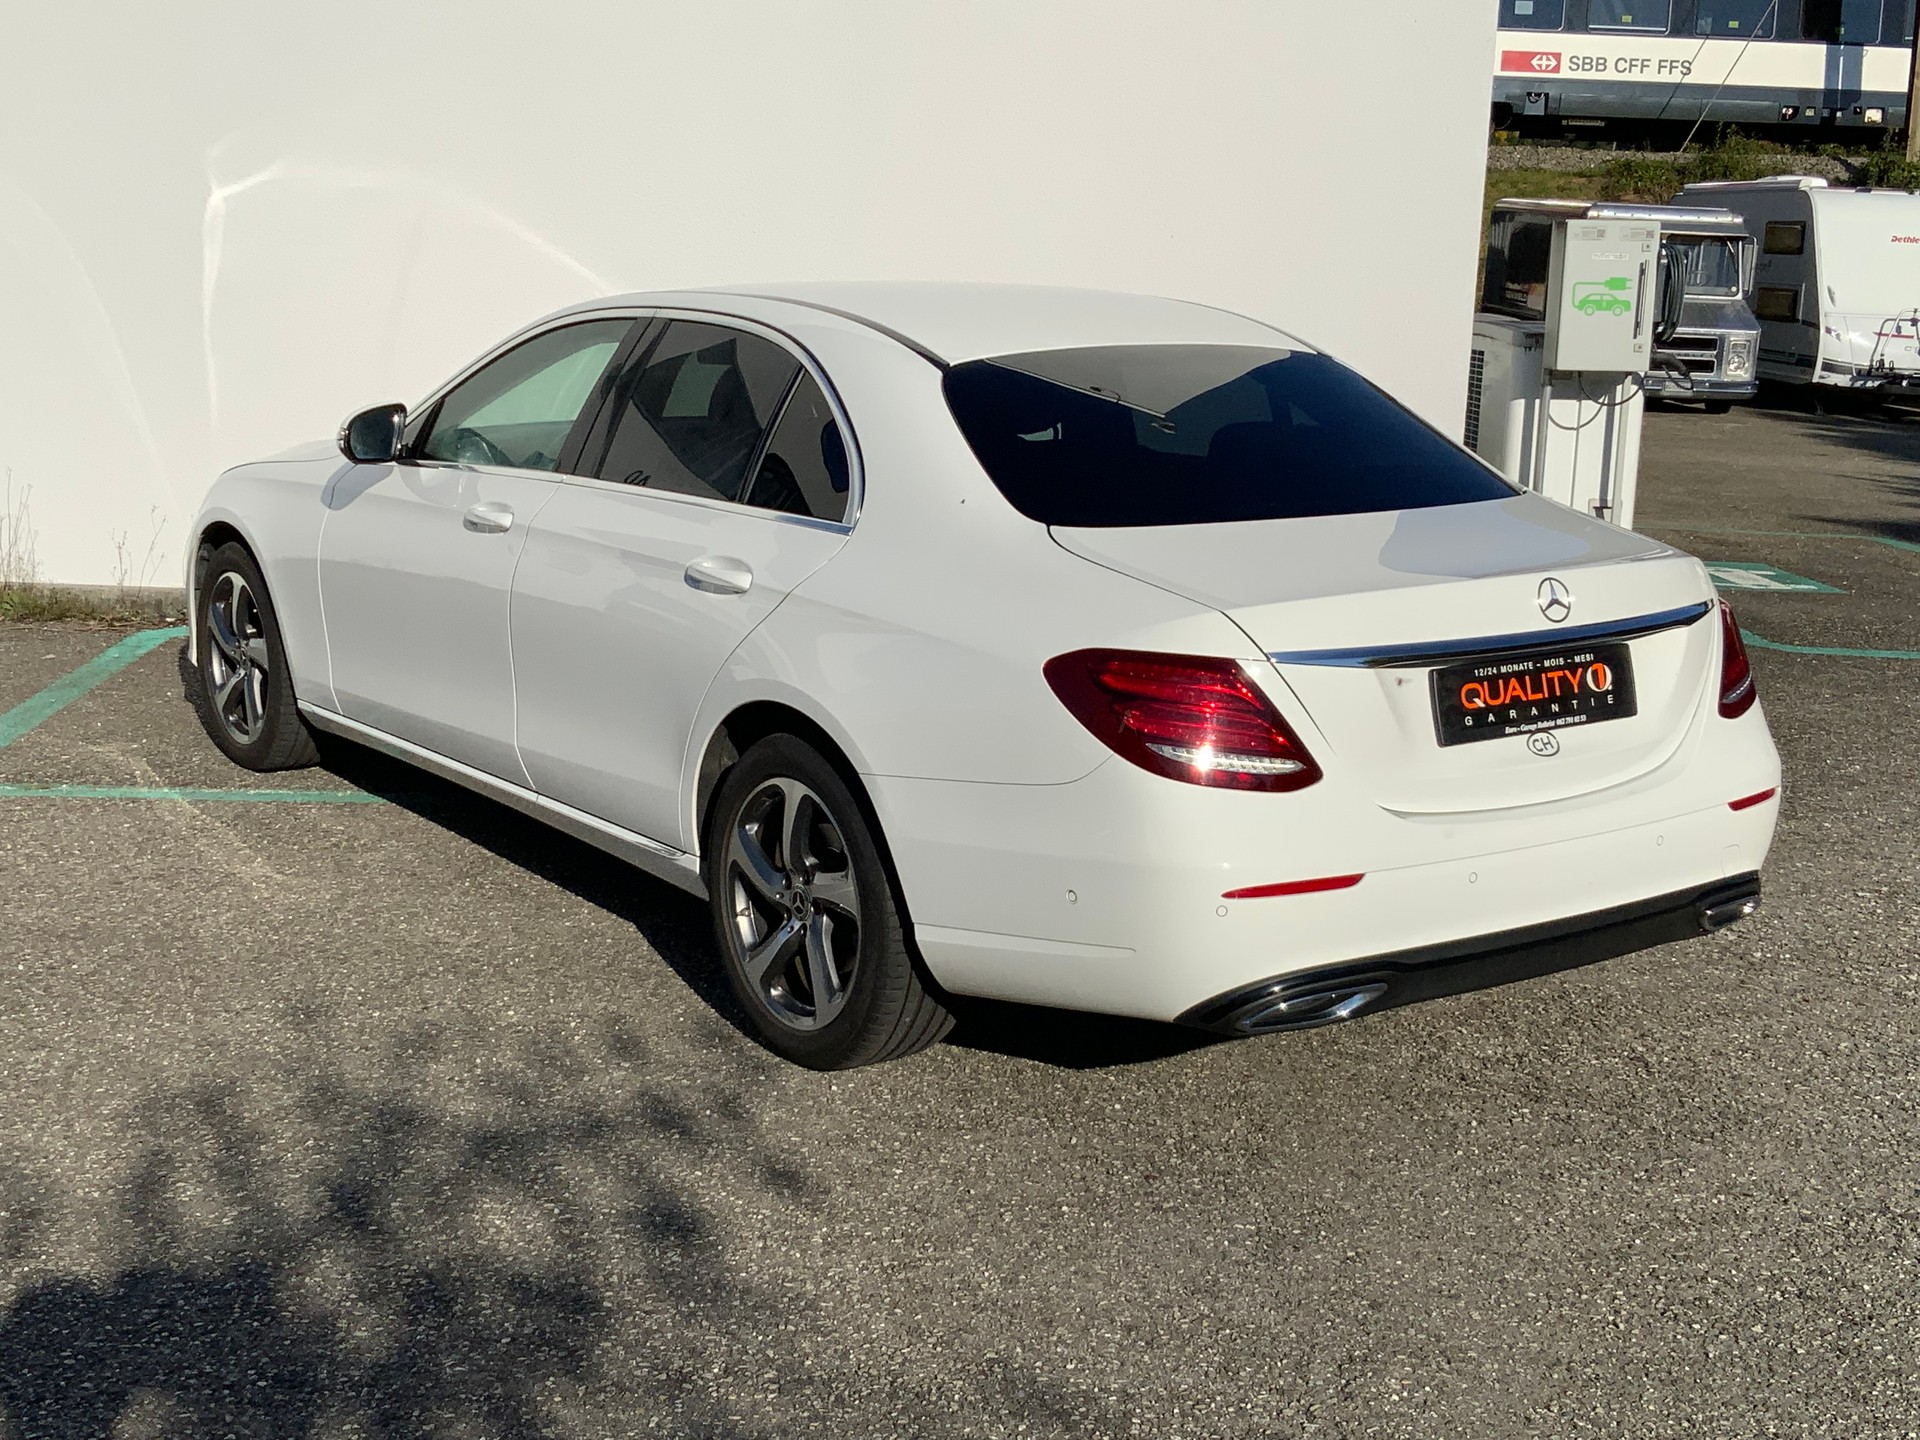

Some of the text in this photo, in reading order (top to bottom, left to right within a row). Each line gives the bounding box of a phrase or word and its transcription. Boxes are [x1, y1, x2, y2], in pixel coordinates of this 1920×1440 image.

[1568, 55, 1692, 76] SBB CFF FFS
[1474, 666, 1497, 677] 12/24
[1500, 661, 1533, 673] MONATE
[1543, 657, 1564, 667] MOIS
[1574, 653, 1594, 663] MESI
[1460, 667, 1583, 710] QUALITY
[1532, 735, 1554, 753] CH
